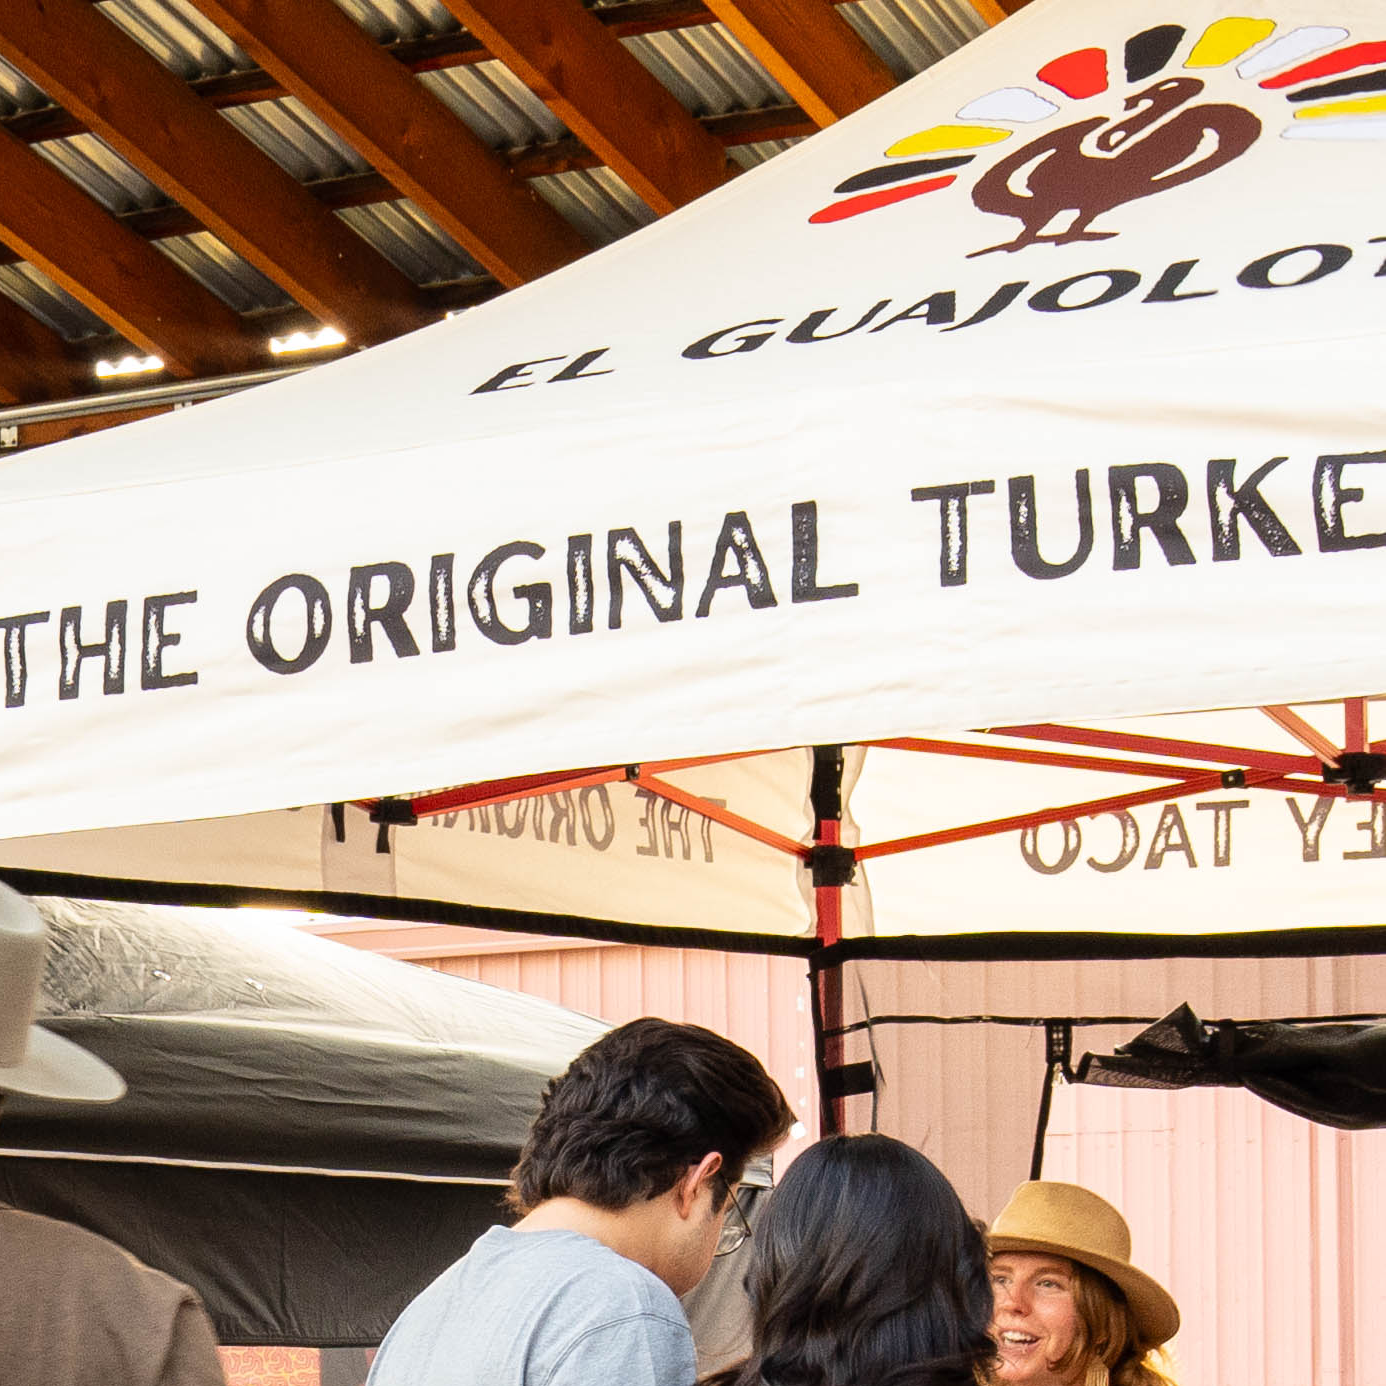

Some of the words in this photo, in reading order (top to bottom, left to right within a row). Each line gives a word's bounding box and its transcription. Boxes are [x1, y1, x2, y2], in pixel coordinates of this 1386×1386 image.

[469, 347, 615, 396] EL
[681, 235, 1386, 361] GUAJOLO
[246, 500, 860, 675] ORIGINAL
[911, 450, 1386, 588] TURKE
